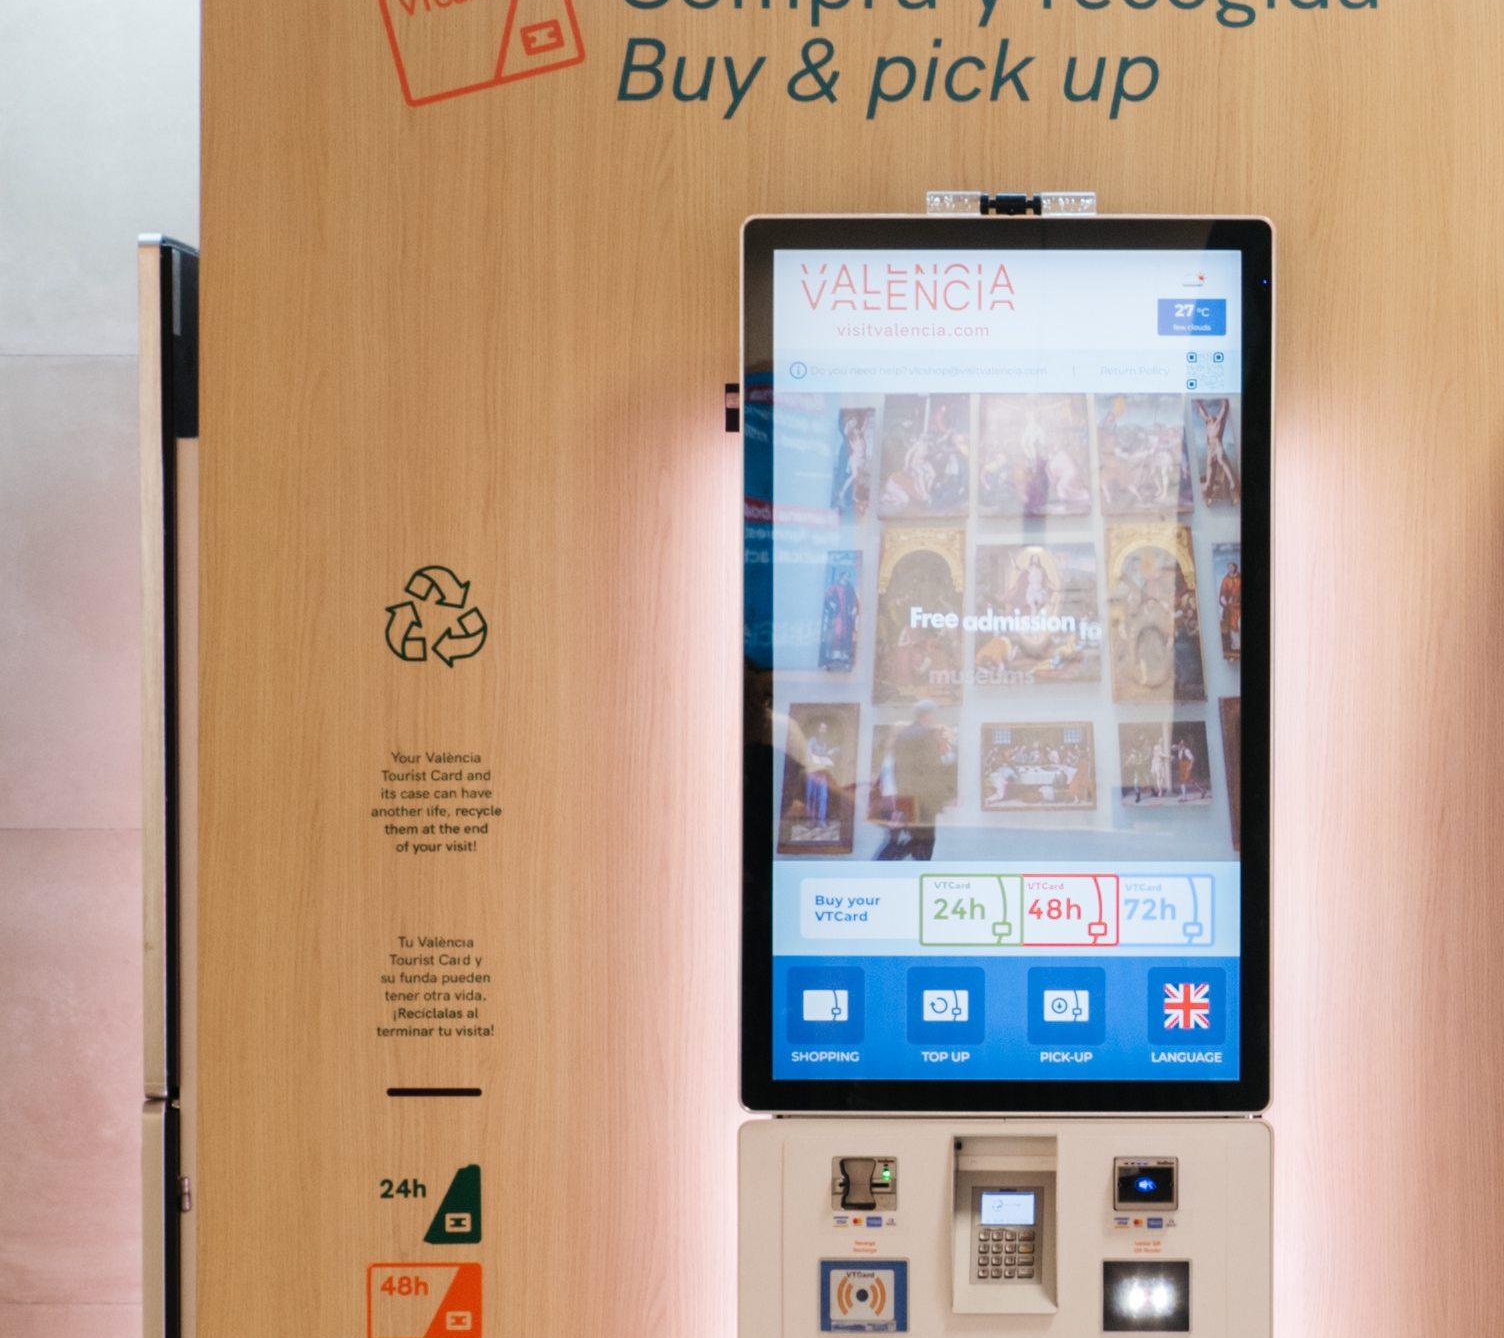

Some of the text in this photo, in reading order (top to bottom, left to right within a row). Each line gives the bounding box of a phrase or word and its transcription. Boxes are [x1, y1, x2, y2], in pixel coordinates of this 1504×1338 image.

[617, 38, 1159, 120] Buy & pick up
[1174, 304, 1194, 318] 27
[837, 322, 990, 337] visitvalencia.com
[910, 606, 1103, 640] Free admission to
[928, 669, 1036, 686] museums
[391, 752, 481, 763] Your València
[381, 770, 491, 781] Tourist Card and
[381, 788, 492, 799] its case can have
[371, 805, 502, 819] another life, recycle
[384, 823, 488, 835] them at the end
[396, 841, 477, 854] of your visit!
[934, 881, 971, 889] VTCard
[1027, 882, 1064, 890] VTCard
[1125, 883, 1162, 891] VTCard
[815, 895, 880, 908] Buy your
[933, 898, 986, 920] 24h
[1028, 898, 1082, 920] 48h
[1123, 898, 1177, 920] 72h
[815, 911, 868, 922] VTCard
[398, 936, 474, 948] Tu València
[390, 954, 482, 968] Tourist Card y
[380, 972, 491, 985] su funda pueden
[385, 990, 487, 1002] tener otra vida.
[377, 1024, 494, 1037] terminar tu visita!
[791, 1051, 860, 1062] SHOPPING
[921, 1051, 970, 1062] TOP UP
[1039, 1051, 1093, 1062] PICK-UP
[1151, 1051, 1223, 1062] LANGUAGE
[380, 1179, 427, 1198] 24h
[380, 1276, 429, 1296] 48h
